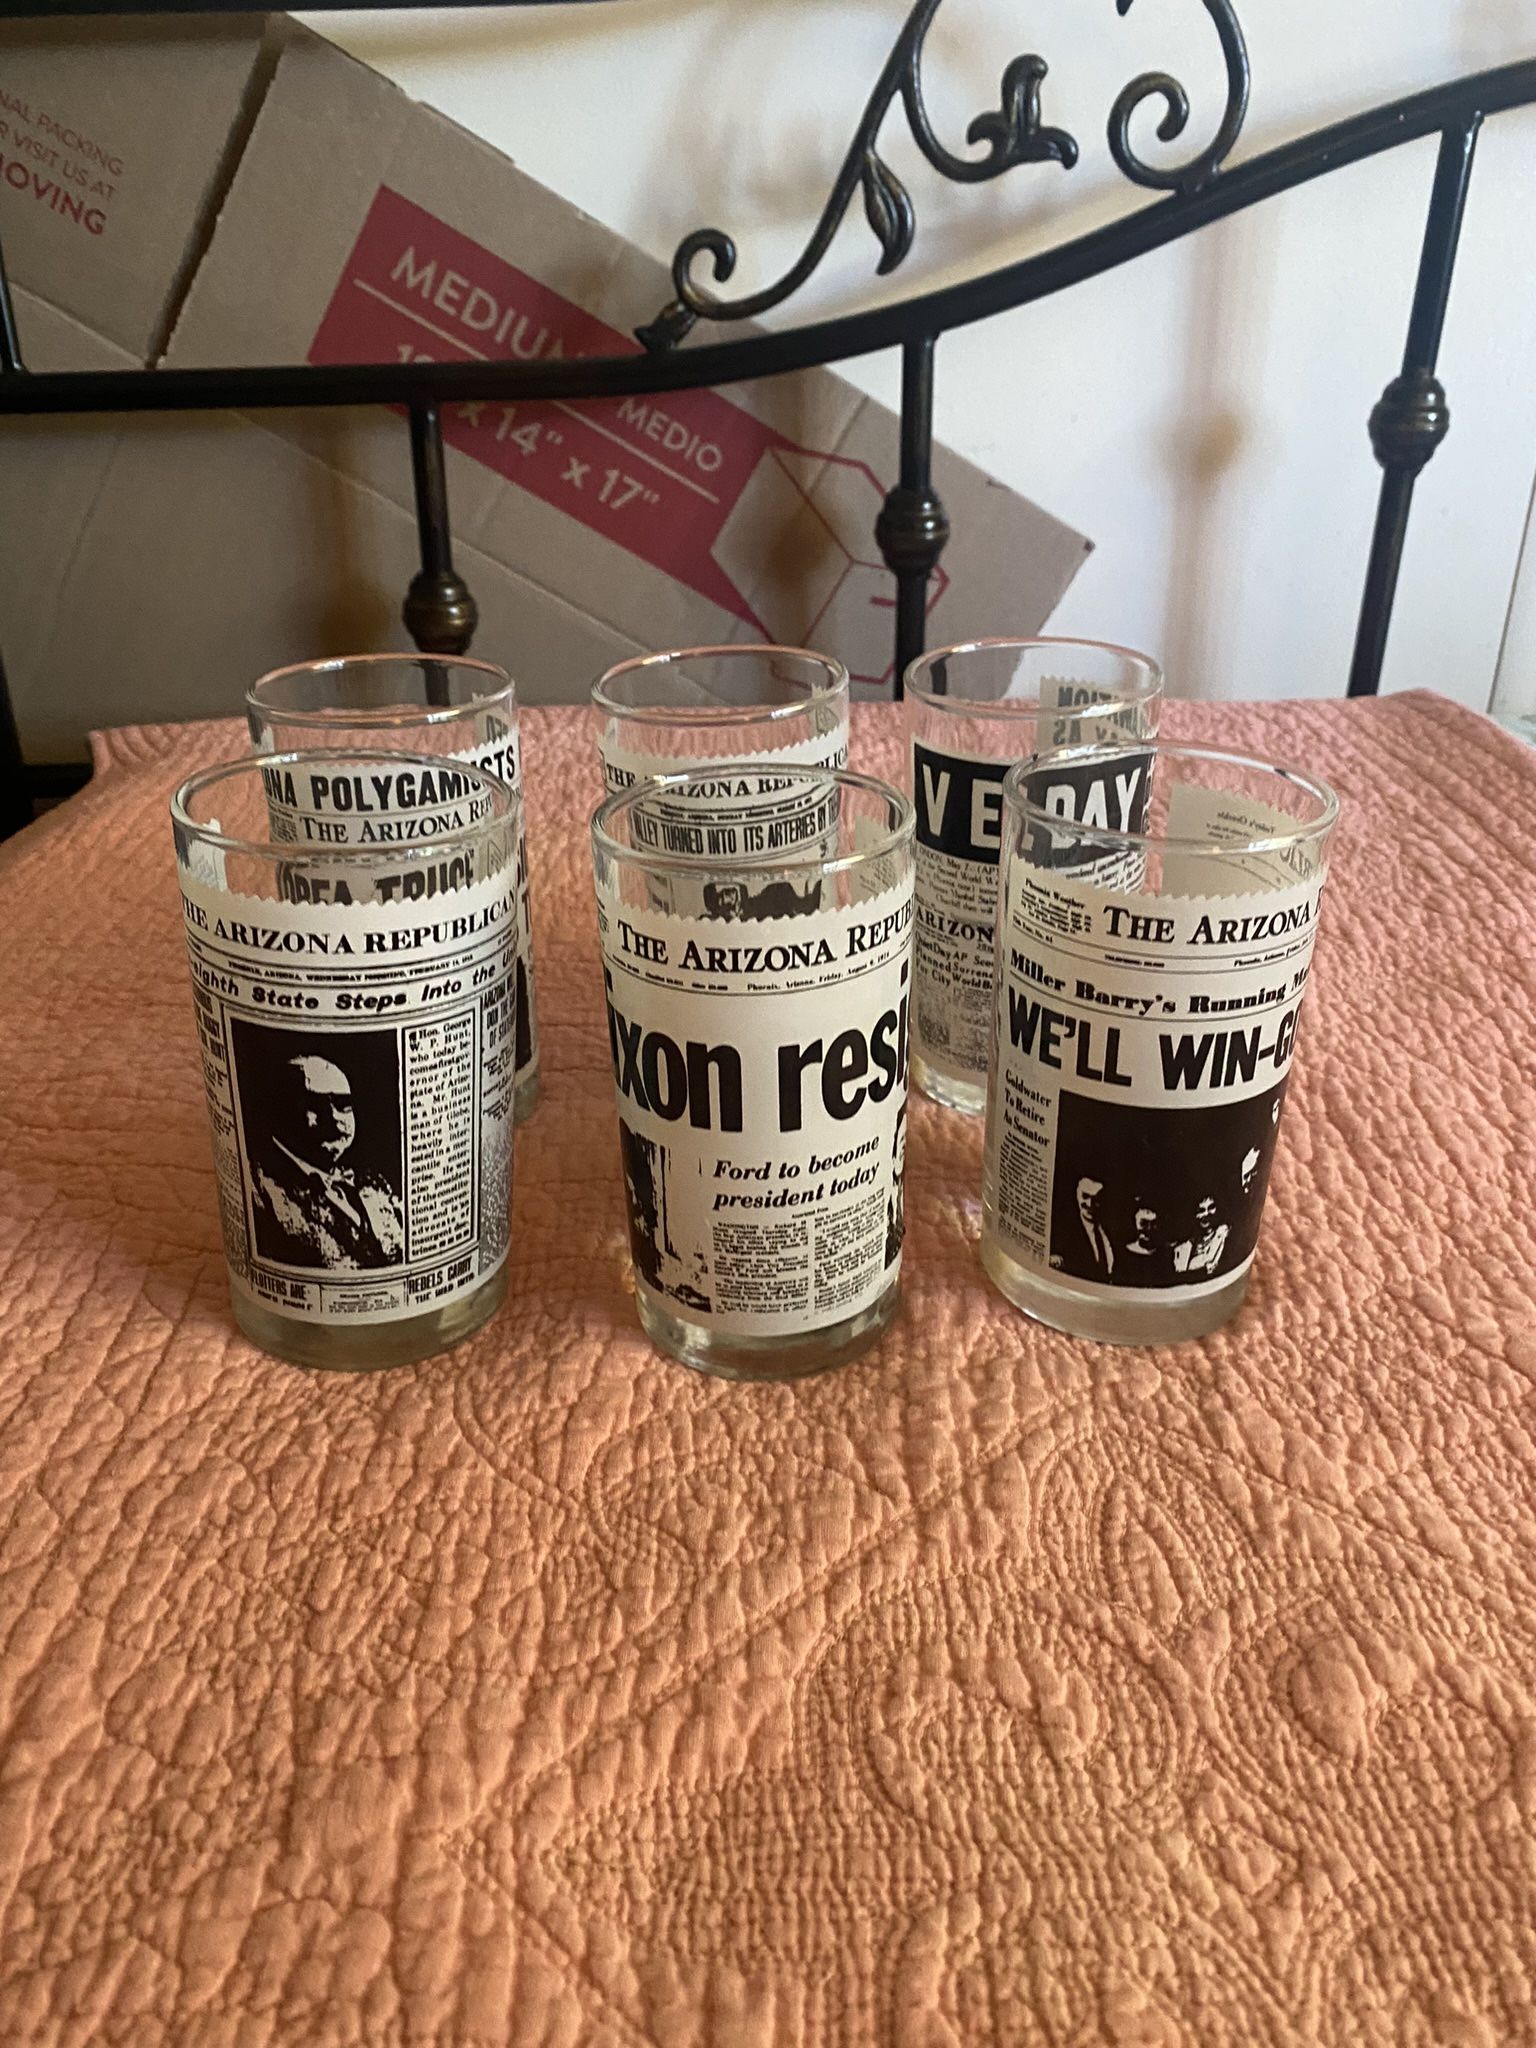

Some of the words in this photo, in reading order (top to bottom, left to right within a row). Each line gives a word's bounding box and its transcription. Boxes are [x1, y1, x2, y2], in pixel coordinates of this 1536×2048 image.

[37, 112, 124, 176] PACKING
[14, 130, 59, 168] VISIT
[63, 160, 89, 187] US
[90, 181, 116, 200] AT
[0, 153, 107, 235] OVING
[391, 246, 585, 362] MEDIU
[617, 399, 722, 472] MEDIO
[562, 457, 590, 488] x
[299, 815, 349, 843] THE
[358, 810, 464, 844] ARIZONA
[661, 822, 704, 855] TURNED
[707, 828, 736, 855] INTO
[743, 825, 764, 853] ITS
[768, 810, 816, 849] ARTERIES
[214, 918, 355, 955] ARIZONA
[364, 886, 514, 954] REPUBLICAN
[1103, 904, 1175, 944] THE
[1187, 902, 1311, 945] ARIZONA
[617, 918, 669, 965] THE
[678, 938, 837, 973] ARIZONA
[953, 951, 968, 960] AP
[252, 986, 320, 1009] State
[335, 992, 408, 1012] Steps
[421, 978, 462, 1002] Into
[472, 964, 496, 986] the
[932, 970, 951, 986] City
[952, 972, 981, 987] World
[1010, 948, 1066, 992] Miller
[1074, 977, 1176, 1015] Barry's
[1187, 982, 1287, 1013] Running
[443, 1017, 471, 1033] George
[1008, 984, 1132, 1087] WE'LL
[410, 1054, 429, 1063] who
[433, 1046, 456, 1058] today
[442, 1068, 453, 1079] of
[457, 1062, 471, 1073] the
[435, 1081, 445, 1092] of
[451, 1083, 471, 1098] Hunt
[1005, 1068, 1052, 1107] Goldwater
[431, 1095, 471, 1115] business
[1005, 1087, 1015, 1107] To
[1016, 1096, 1046, 1126] Retire
[411, 1120, 431, 1131] man
[433, 1115, 443, 1125] of
[411, 1128, 442, 1142] where
[448, 1121, 459, 1131] he
[1003, 1108, 1013, 1126] As
[1013, 1115, 1050, 1147] Senator
[411, 1138, 443, 1153] heavily
[435, 1148, 444, 1157] in
[713, 1159, 770, 1181] Ford
[779, 1163, 800, 1179] to
[808, 1136, 880, 1175] become
[411, 1160, 441, 1174] cantile
[411, 1185, 429, 1195] also
[434, 1167, 470, 1190] president
[442, 1166, 454, 1175] He
[411, 1195, 422, 1206] of
[422, 1192, 437, 1202] the
[712, 1184, 824, 1212] president
[830, 1162, 880, 1197] today
[411, 1201, 437, 1216] tional
[411, 1216, 429, 1226] tion
[432, 1208, 448, 1219] and
[411, 1217, 456, 1237] advocate
[460, 1208, 470, 1219] of
[411, 1227, 452, 1247] insurgent
[409, 1268, 444, 1294] REBELS
